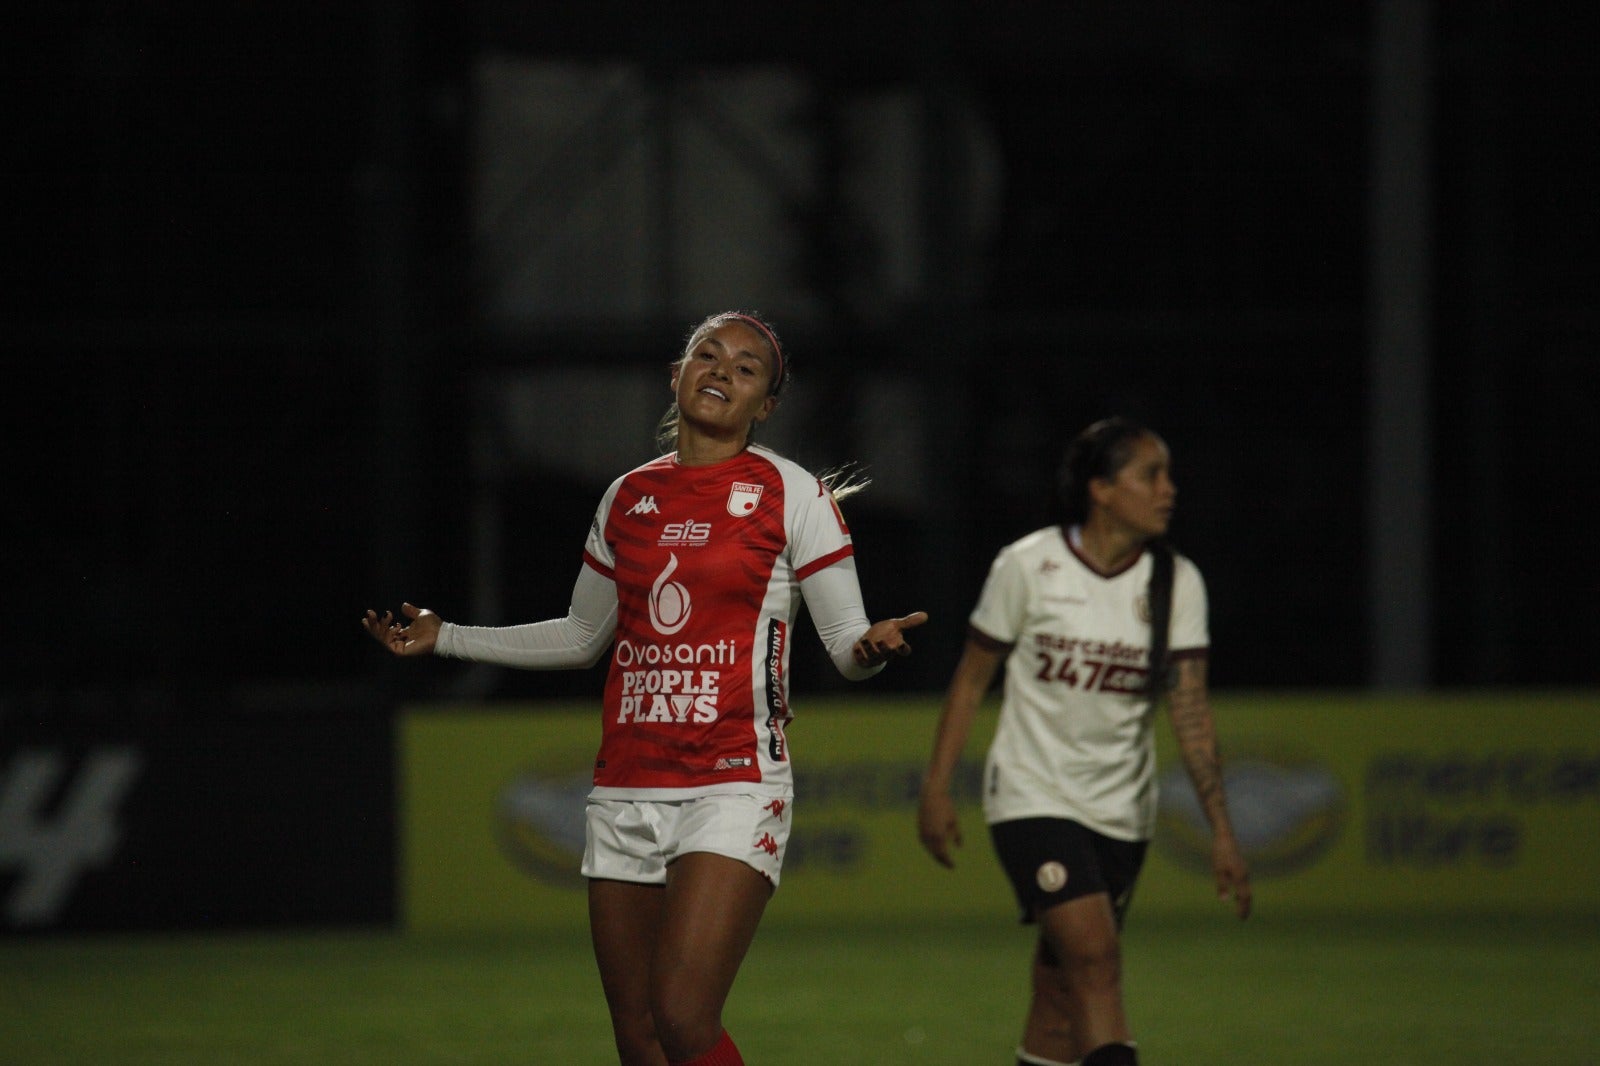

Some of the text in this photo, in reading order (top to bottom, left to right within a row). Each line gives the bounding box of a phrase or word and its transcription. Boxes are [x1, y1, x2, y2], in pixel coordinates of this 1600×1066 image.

[734, 484, 752, 493] SANTA
[616, 639, 735, 667] Ovosanti
[1035, 633, 1143, 660] marcador
[769, 626, 783, 708] D'AGOSTINY
[622, 669, 720, 695] PEOPLE
[617, 694, 719, 723] PLAYS
